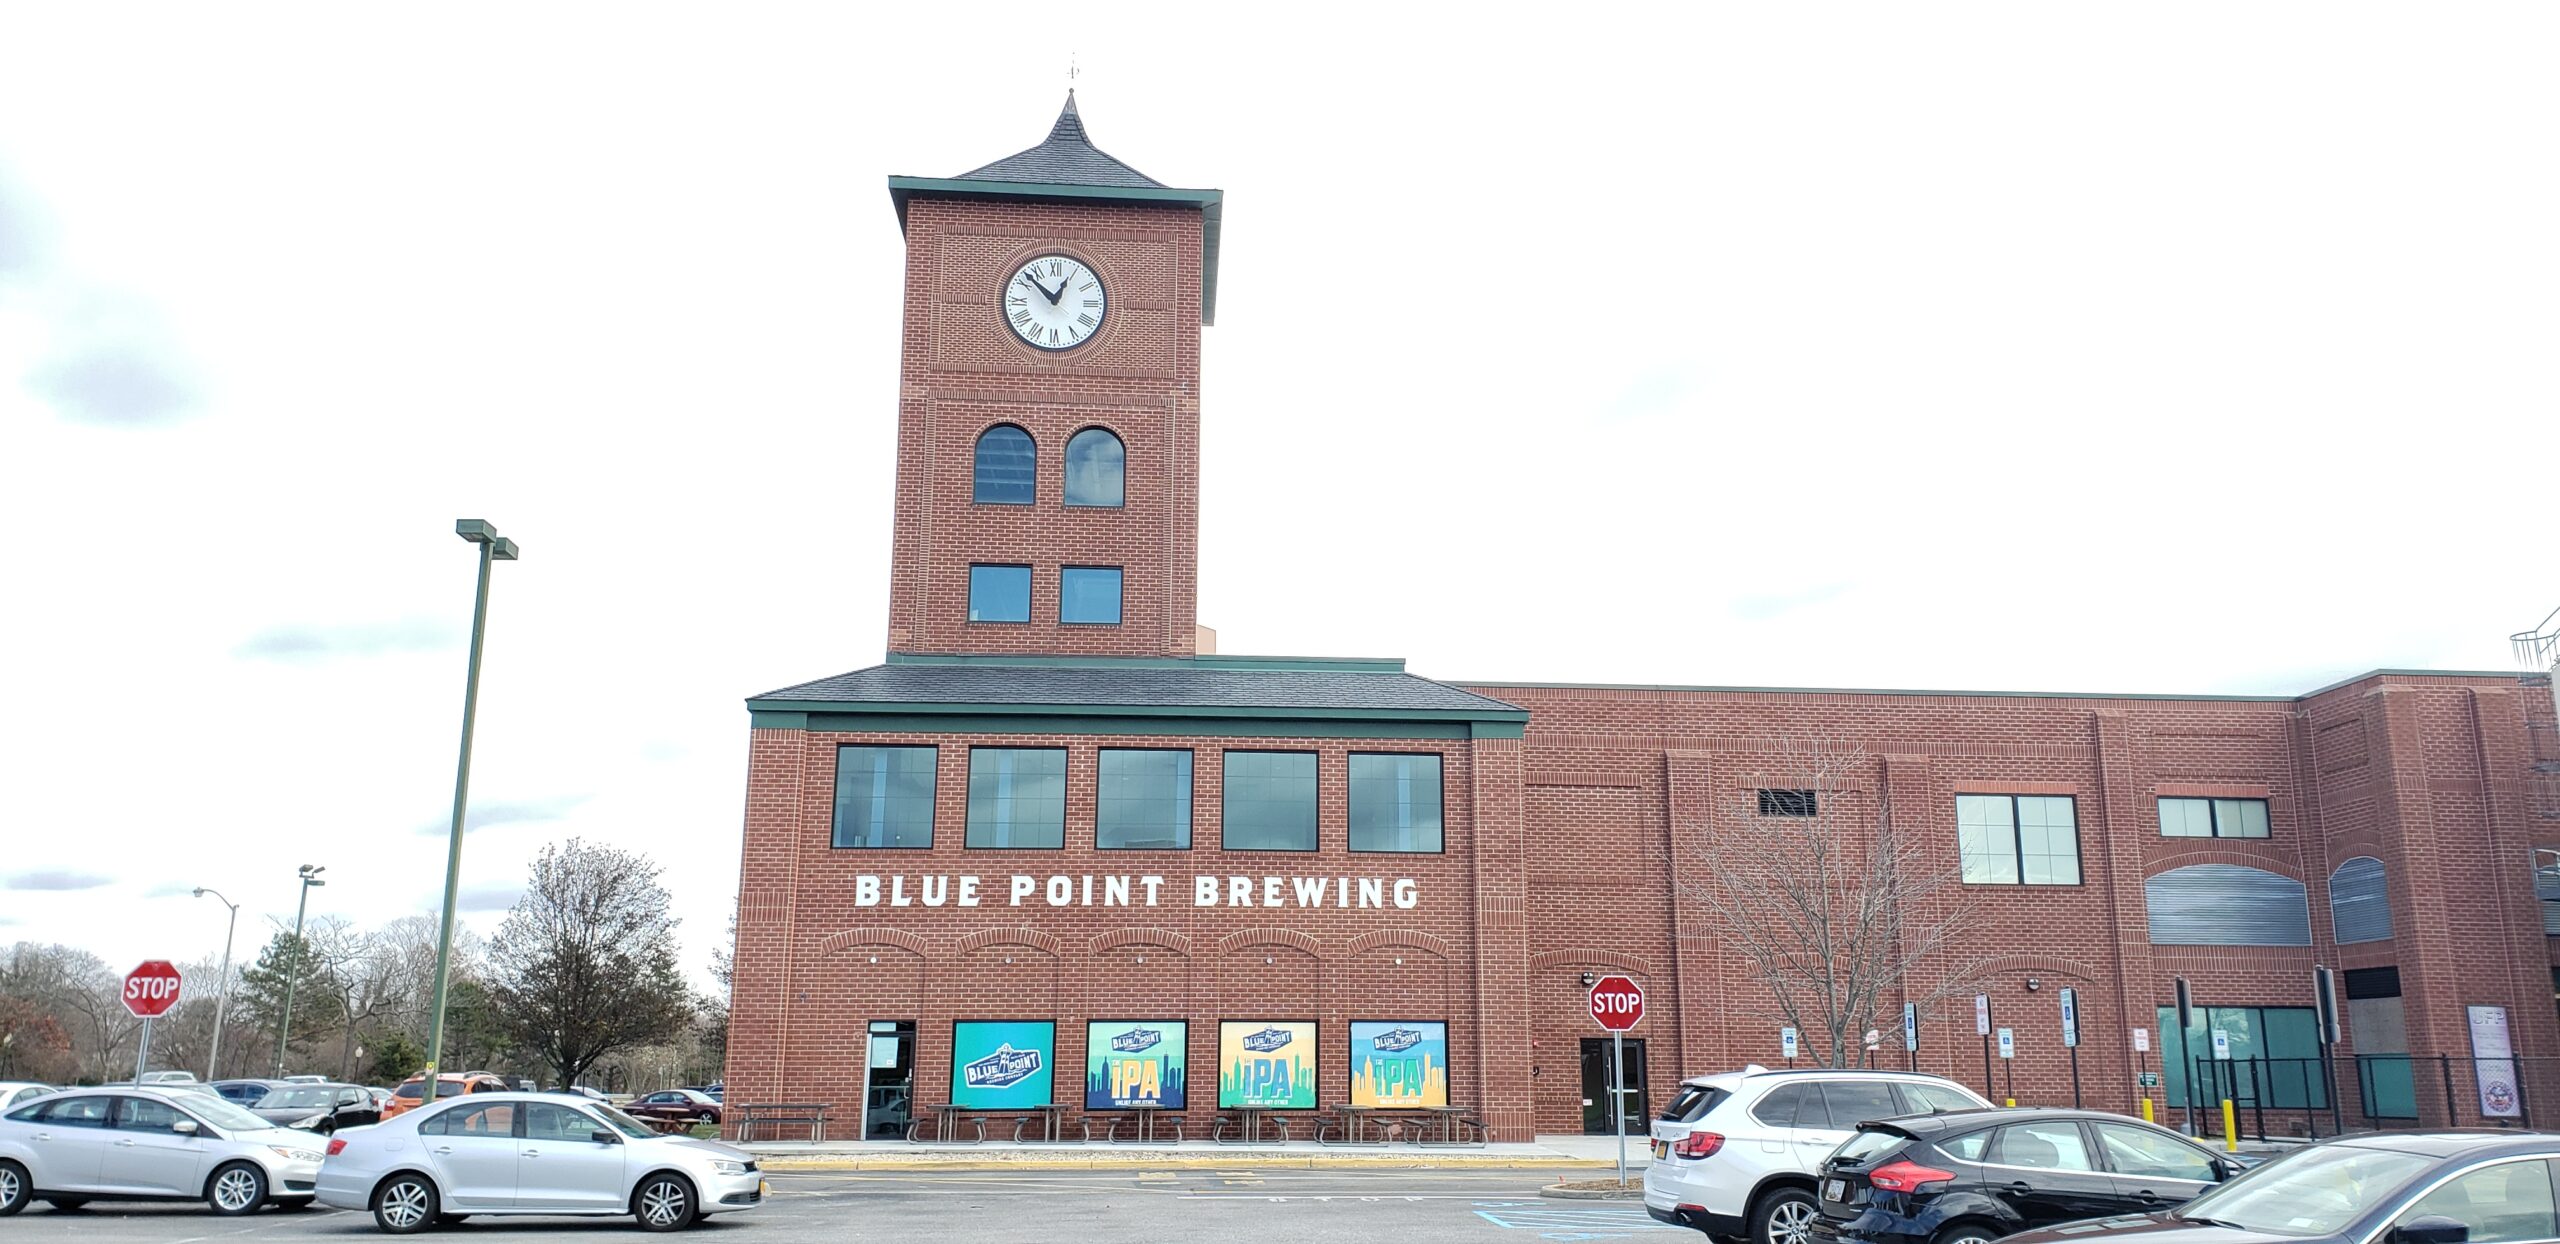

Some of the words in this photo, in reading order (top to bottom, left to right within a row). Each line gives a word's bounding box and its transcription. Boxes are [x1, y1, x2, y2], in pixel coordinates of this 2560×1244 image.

[1050, 262, 1062, 277] XII
[854, 875, 980, 907] BLUE
[1009, 875, 1164, 906] POINT
[1194, 876, 1418, 909] BREWING
[126, 976, 178, 999] STOP
[1593, 992, 1640, 1014] STOP
[1112, 1037, 1134, 1049] BLUE
[1140, 1032, 1160, 1043] POINT
[1244, 1037, 1264, 1049] BLUE
[1271, 1032, 1290, 1043] POINT
[1374, 1037, 1395, 1049] BLUE
[1401, 1032, 1420, 1043] POINT
[968, 1065, 998, 1082] BLUE
[1009, 1053, 1037, 1069] POINT
